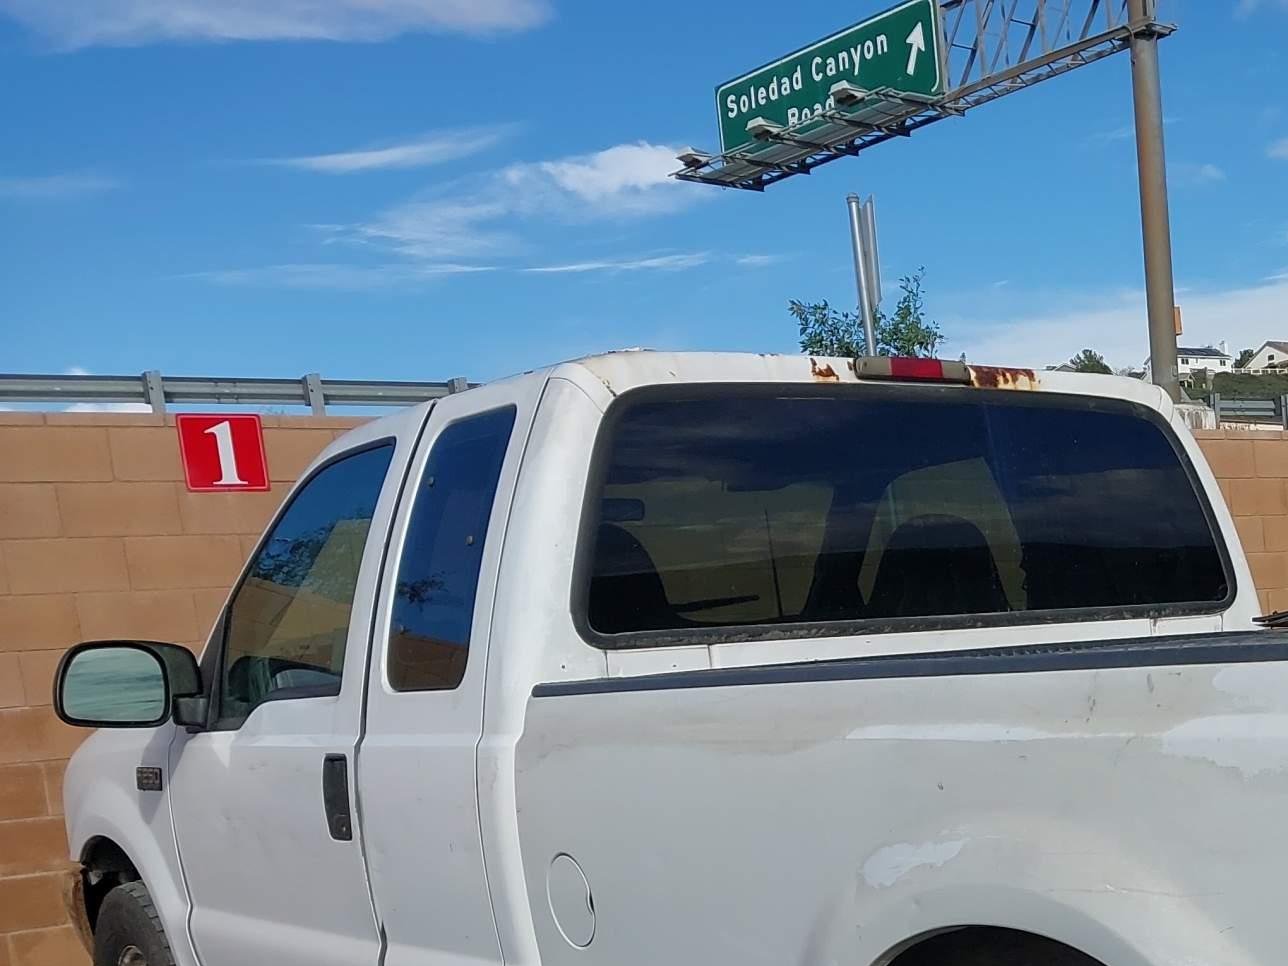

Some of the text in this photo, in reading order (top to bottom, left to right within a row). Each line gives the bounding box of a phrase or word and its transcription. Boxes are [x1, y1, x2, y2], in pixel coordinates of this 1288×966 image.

[727, 34, 888, 118] Soledad Canyon
[203, 420, 248, 485] 1
